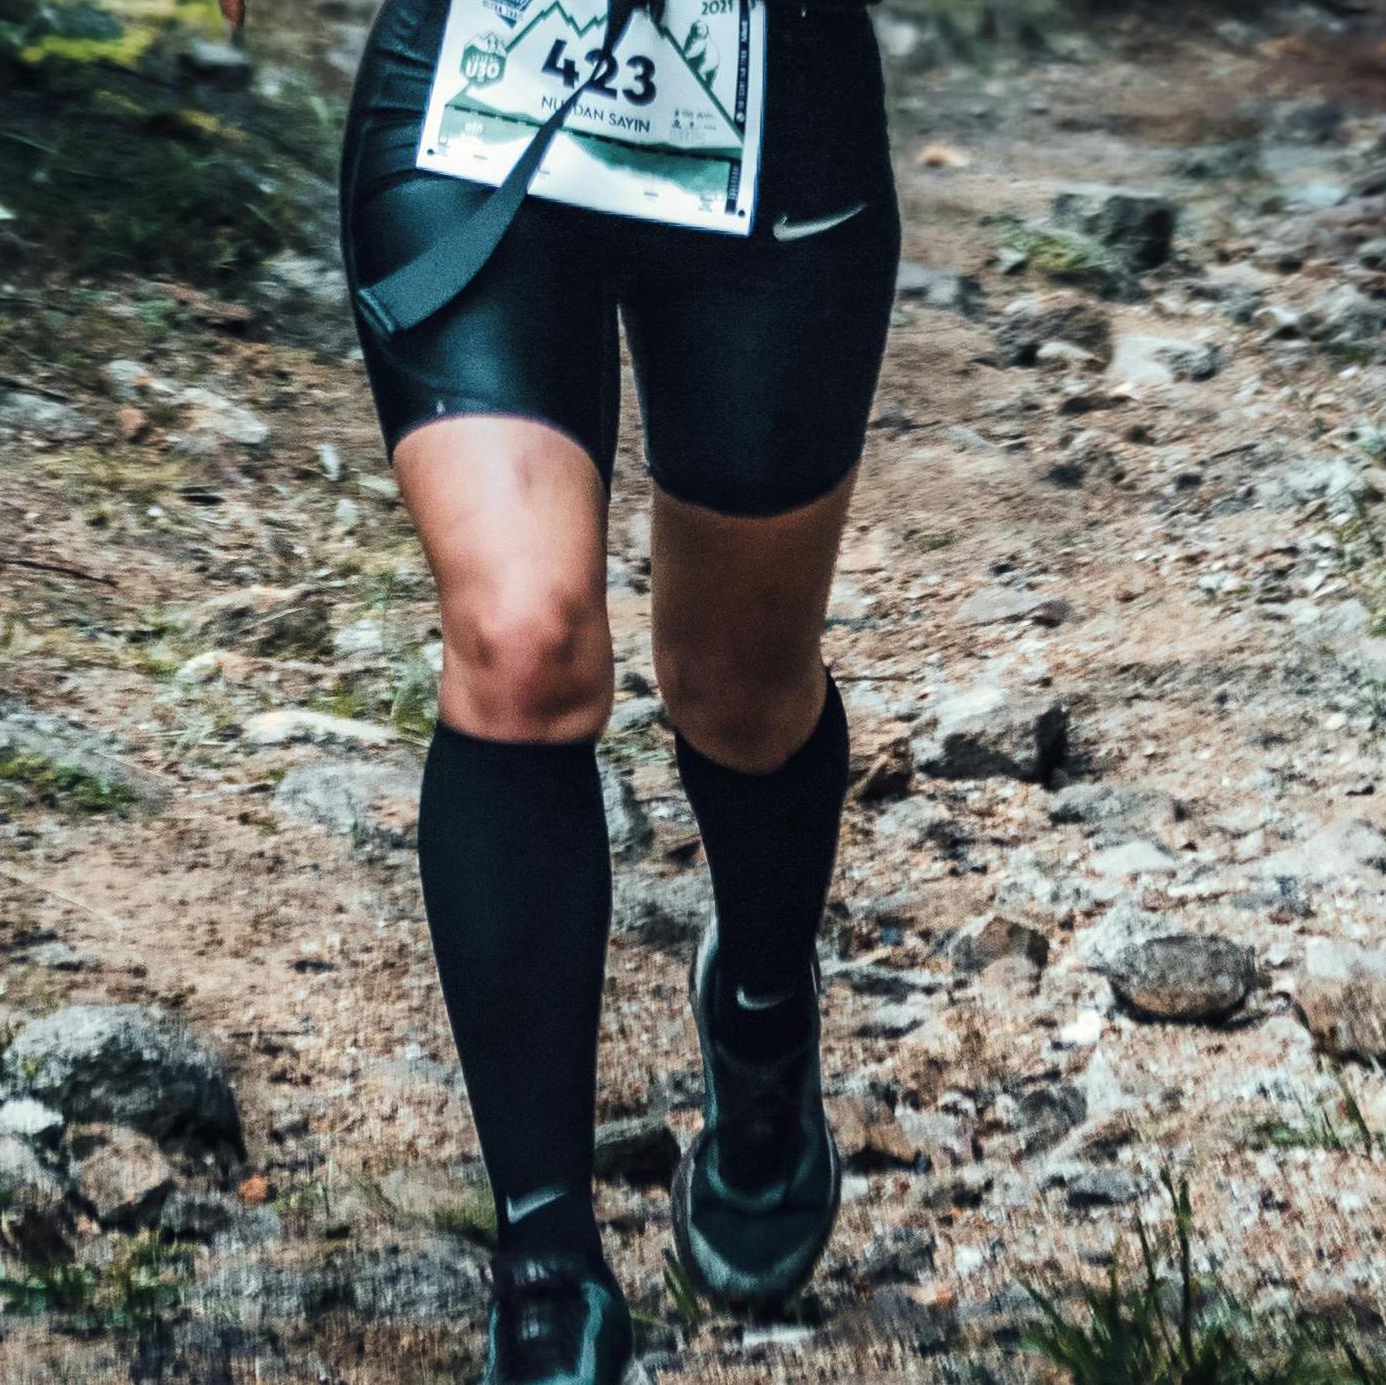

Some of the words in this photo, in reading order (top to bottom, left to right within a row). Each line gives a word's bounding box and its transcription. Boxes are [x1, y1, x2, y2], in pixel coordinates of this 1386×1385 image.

[541, 37, 657, 107] 423
[541, 95, 605, 121] NUDAN
[608, 112, 651, 133] SAYIN
